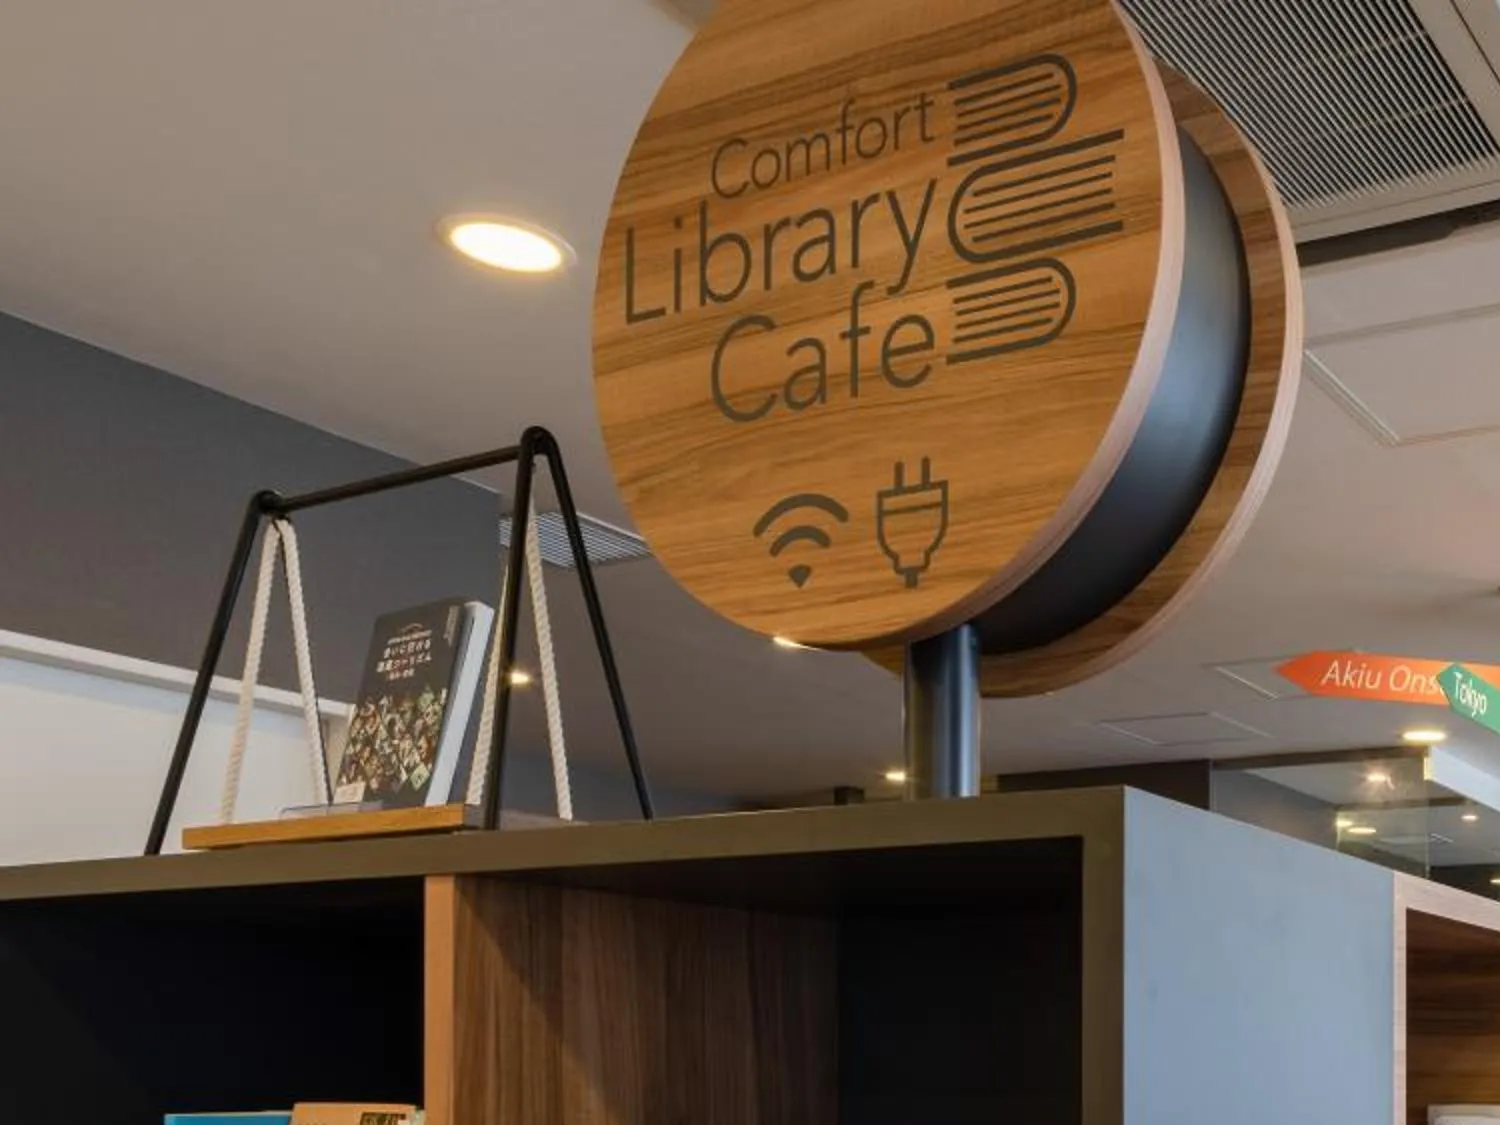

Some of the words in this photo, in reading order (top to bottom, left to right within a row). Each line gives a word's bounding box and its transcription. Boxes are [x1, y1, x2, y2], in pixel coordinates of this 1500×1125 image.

[709, 91, 936, 200] Comfort
[624, 177, 937, 325] Library
[710, 279, 936, 423] Cafe
[1321, 659, 1381, 692] Akiu
[1388, 664, 1446, 698] Ons
[1452, 671, 1488, 718] Tokyo
